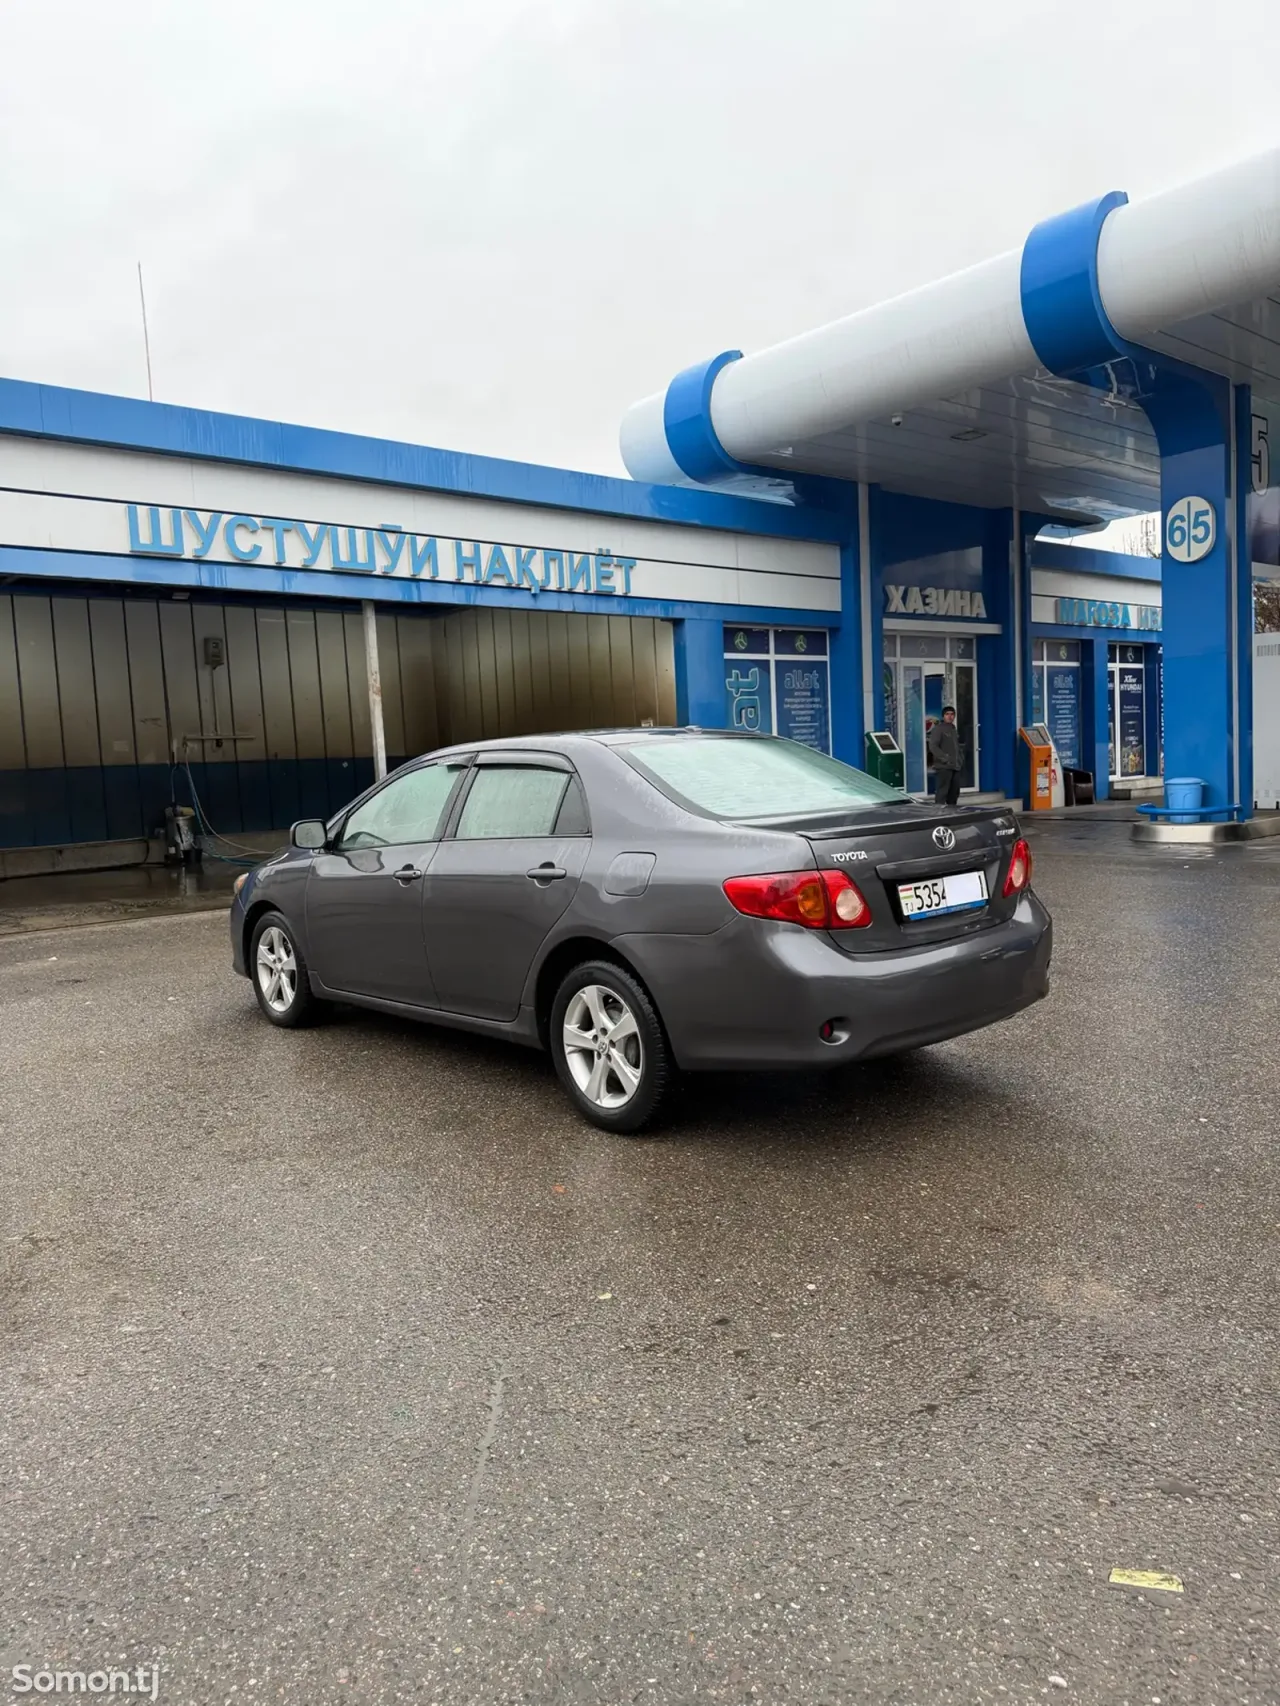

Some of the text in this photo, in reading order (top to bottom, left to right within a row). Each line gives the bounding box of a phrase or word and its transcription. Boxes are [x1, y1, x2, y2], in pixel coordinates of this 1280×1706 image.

[126, 505, 637, 595] ШУСТУШӮИ НАҚЛИЁТ
[885, 585, 987, 618] ХАЗИНА
[784, 669, 820, 690] allat
[831, 850, 868, 862] TOYOTA
